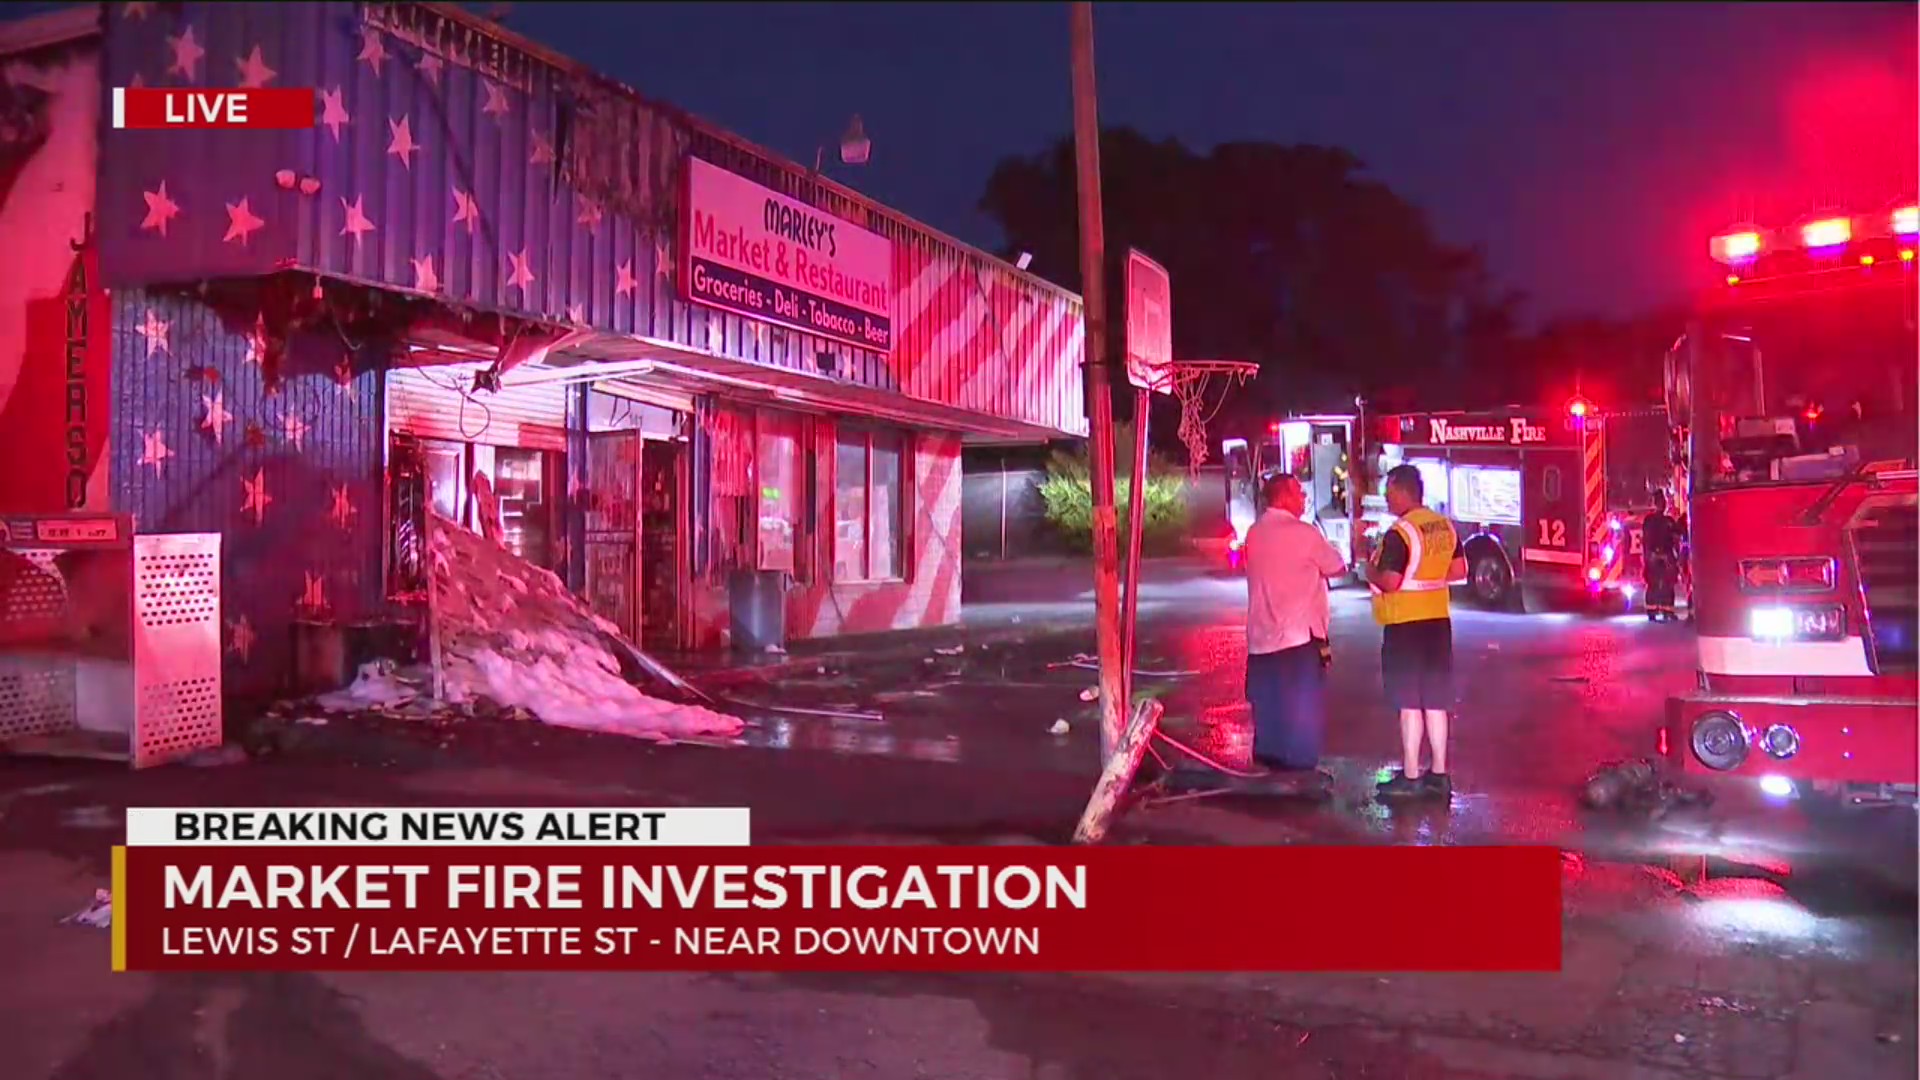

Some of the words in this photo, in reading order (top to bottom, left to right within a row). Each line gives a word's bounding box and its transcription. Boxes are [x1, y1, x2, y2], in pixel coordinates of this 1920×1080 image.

[764, 198, 836, 258] MARLEY'S
[694, 210, 771, 273] Market
[775, 241, 790, 279] &
[795, 250, 888, 311] Restaurant
[694, 264, 763, 308] Groceries
[775, 289, 799, 319] Deli
[808, 300, 856, 335] Tobacco
[864, 318, 889, 344] Beer
[1429, 418, 1505, 444] NASHVILLE
[1510, 417, 1546, 444] FIRE
[1539, 518, 1566, 547] 12
